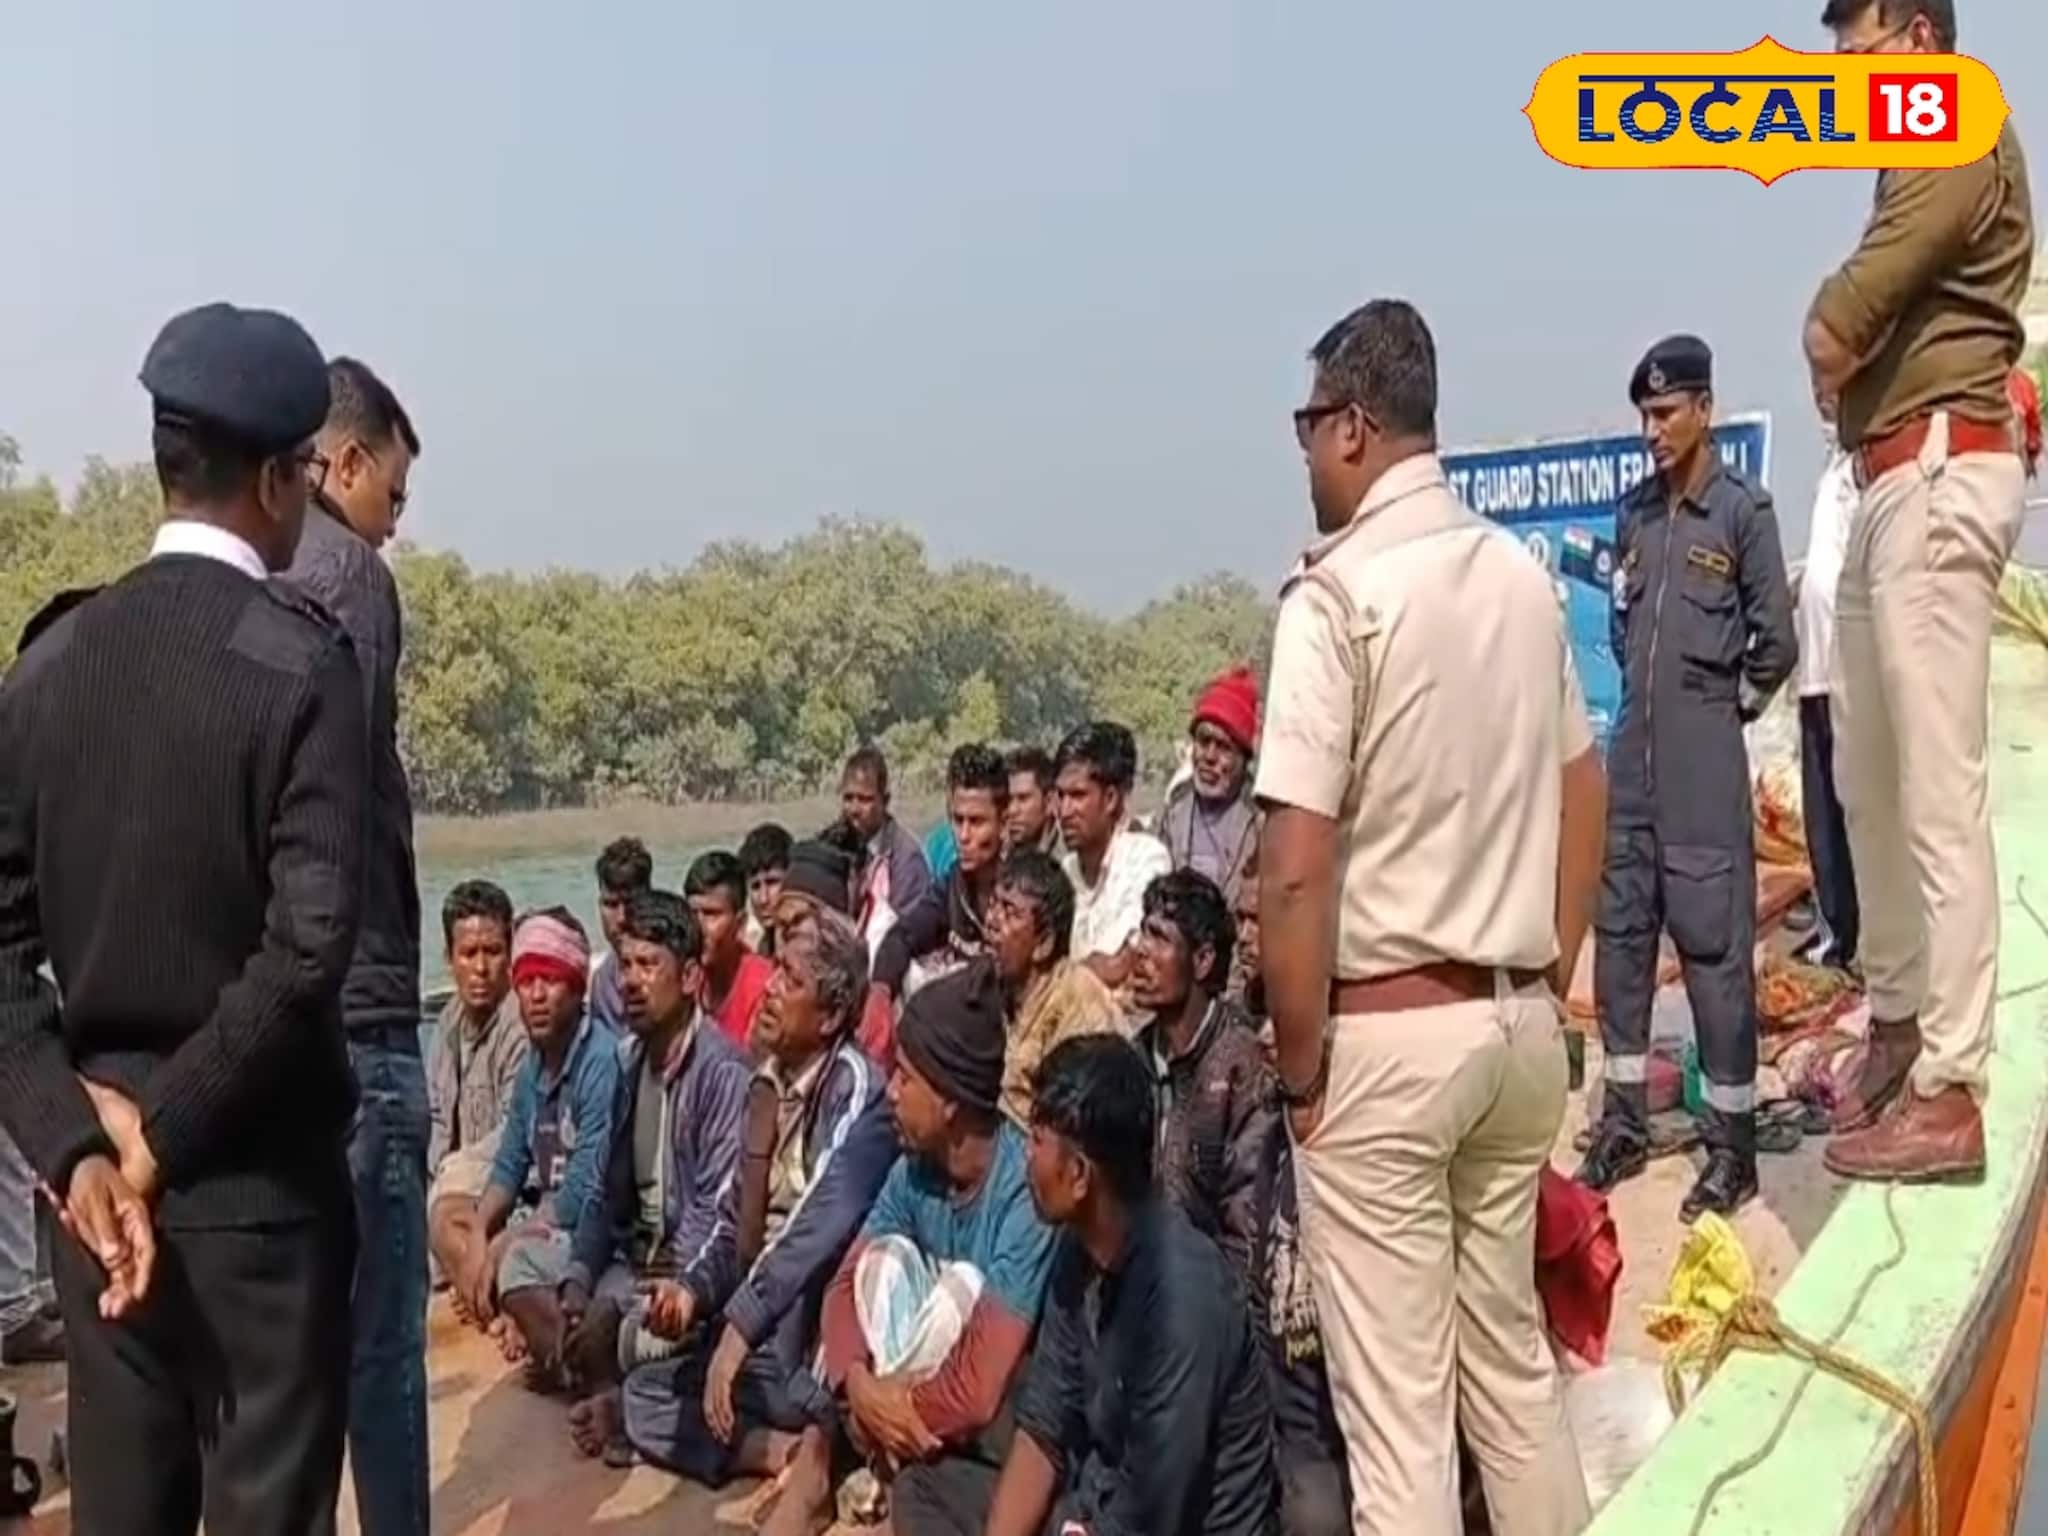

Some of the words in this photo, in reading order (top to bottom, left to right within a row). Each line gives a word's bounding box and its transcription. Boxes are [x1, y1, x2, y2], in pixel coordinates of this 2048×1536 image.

[1448, 469, 1469, 509] ST
[1474, 465, 1534, 512] GUARD
[1537, 455, 1615, 507] STATION
